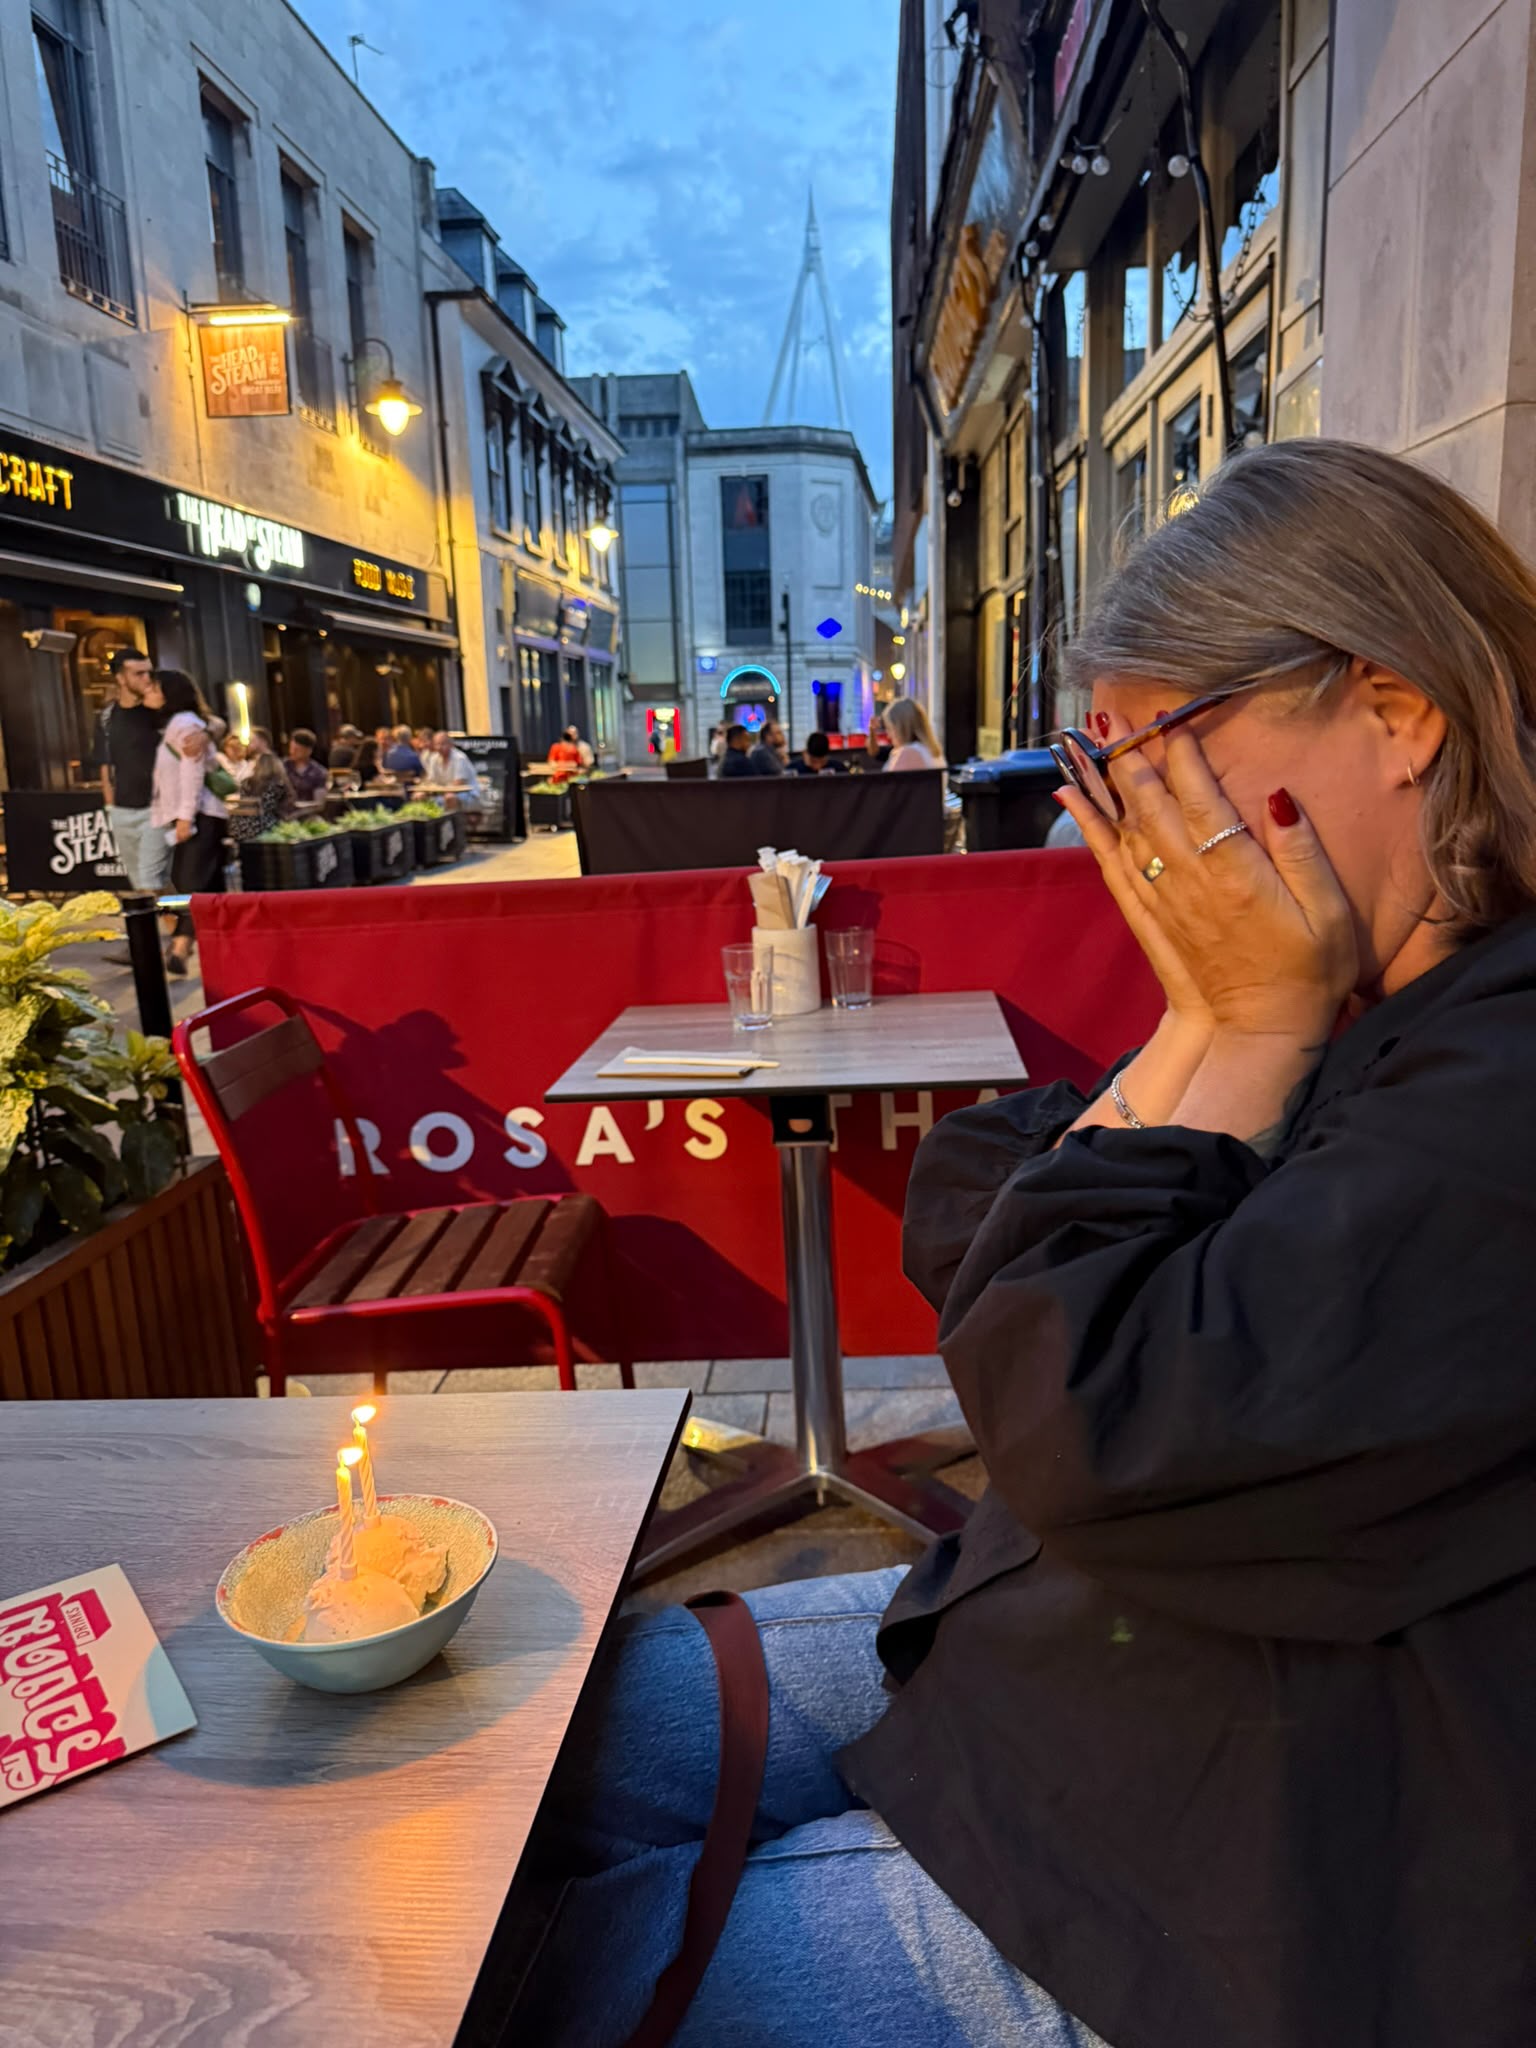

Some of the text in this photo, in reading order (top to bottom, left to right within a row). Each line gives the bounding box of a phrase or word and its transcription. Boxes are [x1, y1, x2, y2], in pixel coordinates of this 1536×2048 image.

[211, 358, 268, 395] STEAM
[219, 345, 258, 370] HEAD
[0, 451, 74, 511] CRAFT
[199, 499, 248, 557] HEAD
[254, 518, 305, 572] STEAM
[50, 830, 121, 875] STEA
[65, 1606, 91, 1640] DRINKS
